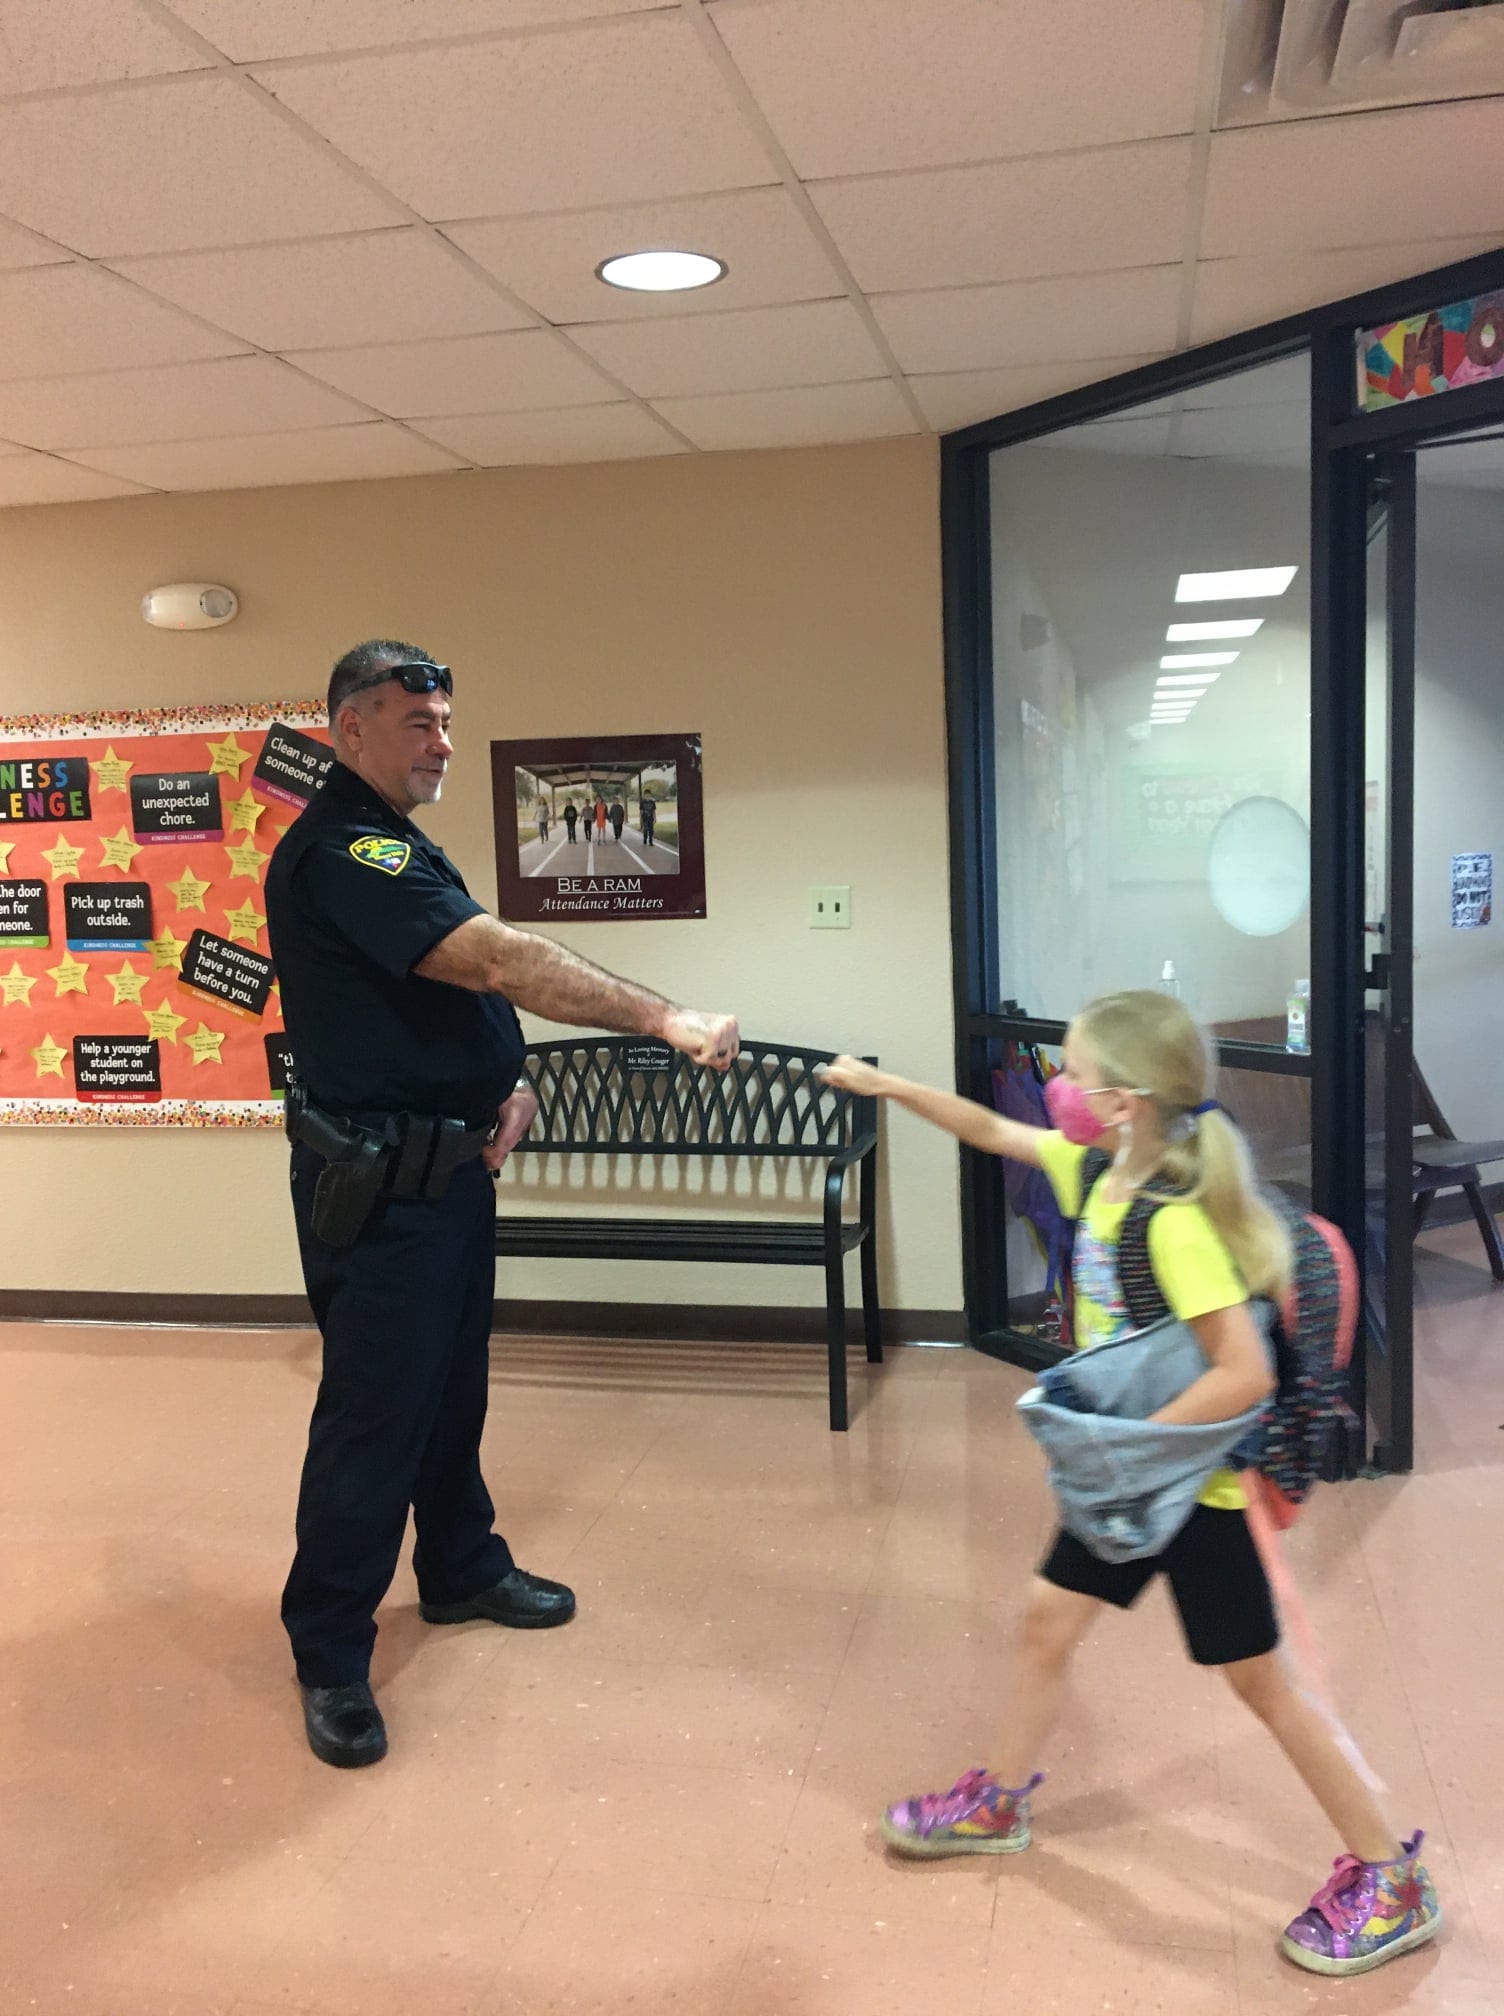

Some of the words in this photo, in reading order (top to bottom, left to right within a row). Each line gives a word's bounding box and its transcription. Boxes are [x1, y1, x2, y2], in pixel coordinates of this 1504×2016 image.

[270, 737, 300, 760] Clean
[302, 754, 317, 769] up
[0, 761, 68, 789] NESS
[264, 755, 314, 785] someone
[315, 780, 327, 790] e
[158, 779, 173, 791] Do
[176, 780, 191, 790] an
[142, 792, 210, 811] unexpected
[159, 811, 195, 825] chore.
[17, 884, 42, 898] door
[587, 880, 599, 891] A
[604, 879, 641, 891] RAM
[13, 901, 29, 914] for
[71, 894, 95, 909] Pick
[97, 899, 112, 912] up
[114, 894, 145, 909] trash
[539, 896, 610, 912] Attendance
[612, 897, 664, 910] Matters
[87, 912, 131, 926] outside.
[200, 935, 219, 953] Let
[220, 947, 269, 975] someone
[197, 951, 224, 973] have
[225, 967, 233, 978] a
[235, 970, 260, 989] turn
[193, 967, 229, 993] before
[228, 987, 253, 1004] you.
[81, 1042, 101, 1057] Help
[104, 1045, 110, 1054] a
[111, 1045, 152, 1057] younger
[90, 1056, 129, 1068] student
[131, 1059, 143, 1068] on
[80, 1070, 97, 1082] the
[99, 1070, 156, 1085] playground.
